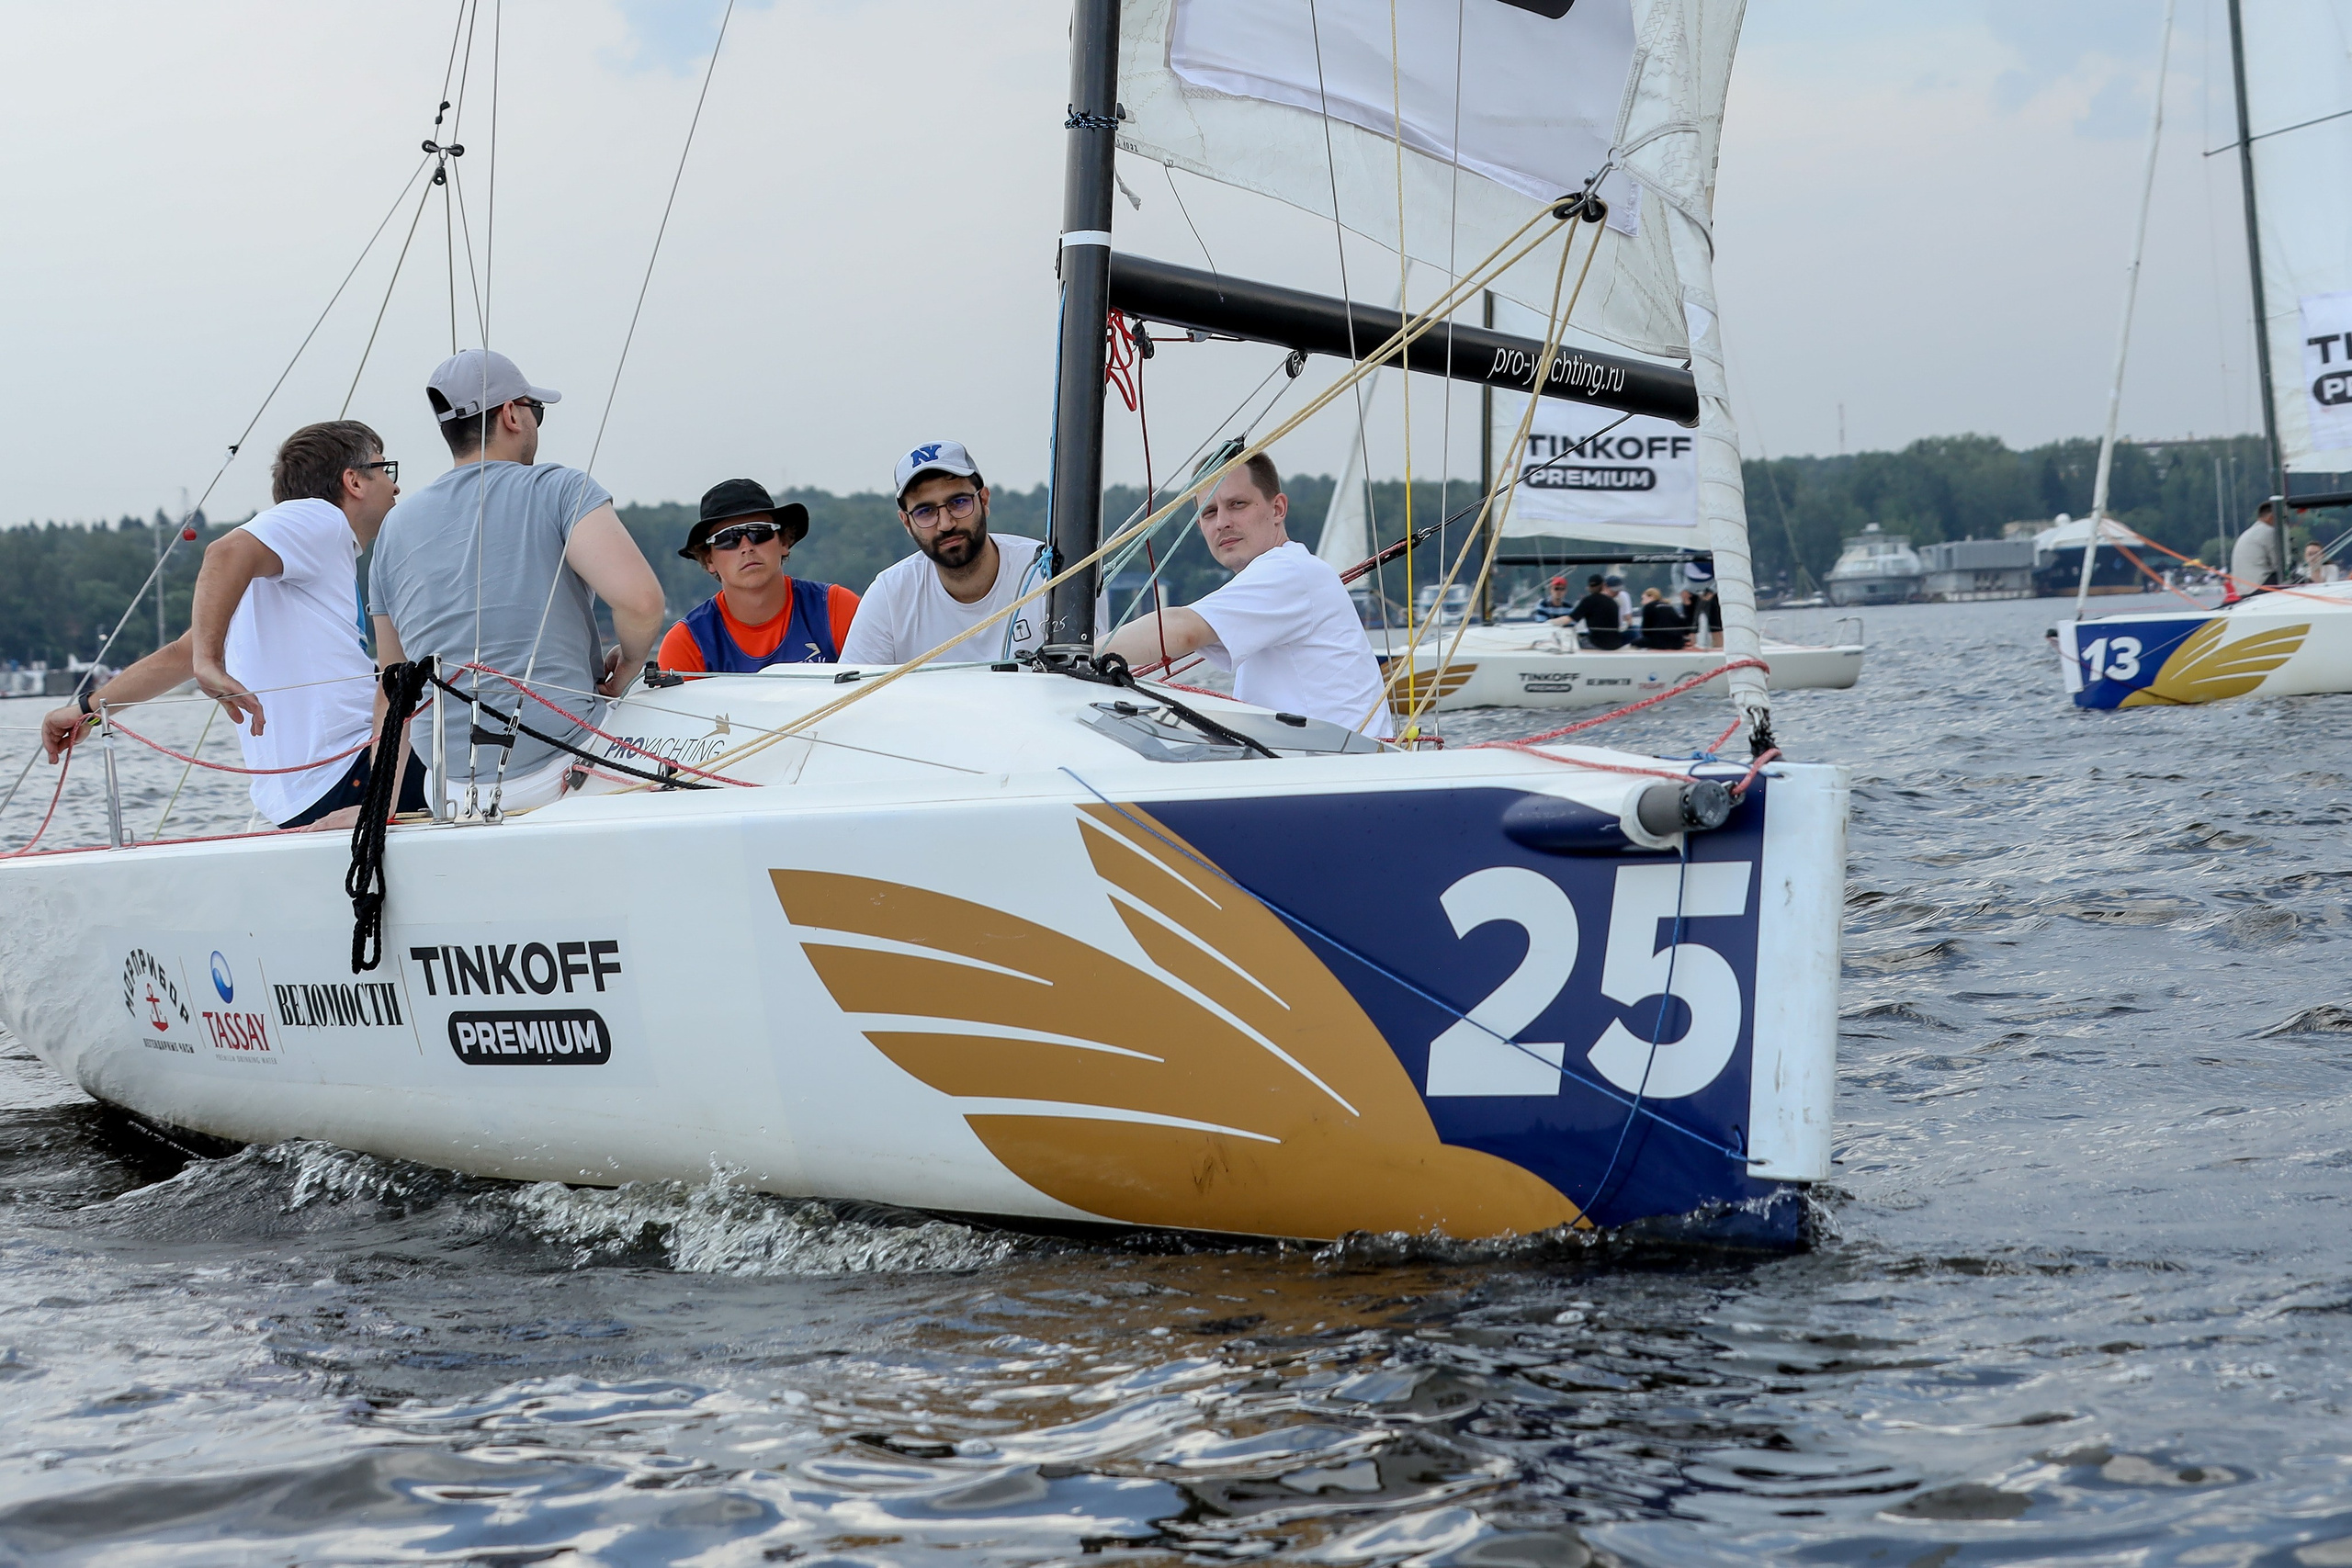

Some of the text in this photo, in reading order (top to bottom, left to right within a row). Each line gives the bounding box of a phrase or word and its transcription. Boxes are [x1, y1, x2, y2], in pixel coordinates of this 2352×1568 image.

[1487, 345, 1626, 397] pro-ychting.ru
[1521, 433, 1692, 461] TINKOFF
[1528, 467, 1650, 489] PREMIUM
[2080, 636, 2143, 682] 13
[604, 736, 725, 762] PROYACHTING
[410, 940, 622, 996] TINKOFF
[1425, 860, 1753, 1100] 25
[273, 982, 404, 1033] ВЕДОМОСТИ
[202, 1011, 271, 1052] TASSAY
[456, 1020, 602, 1055] PREMIUM
